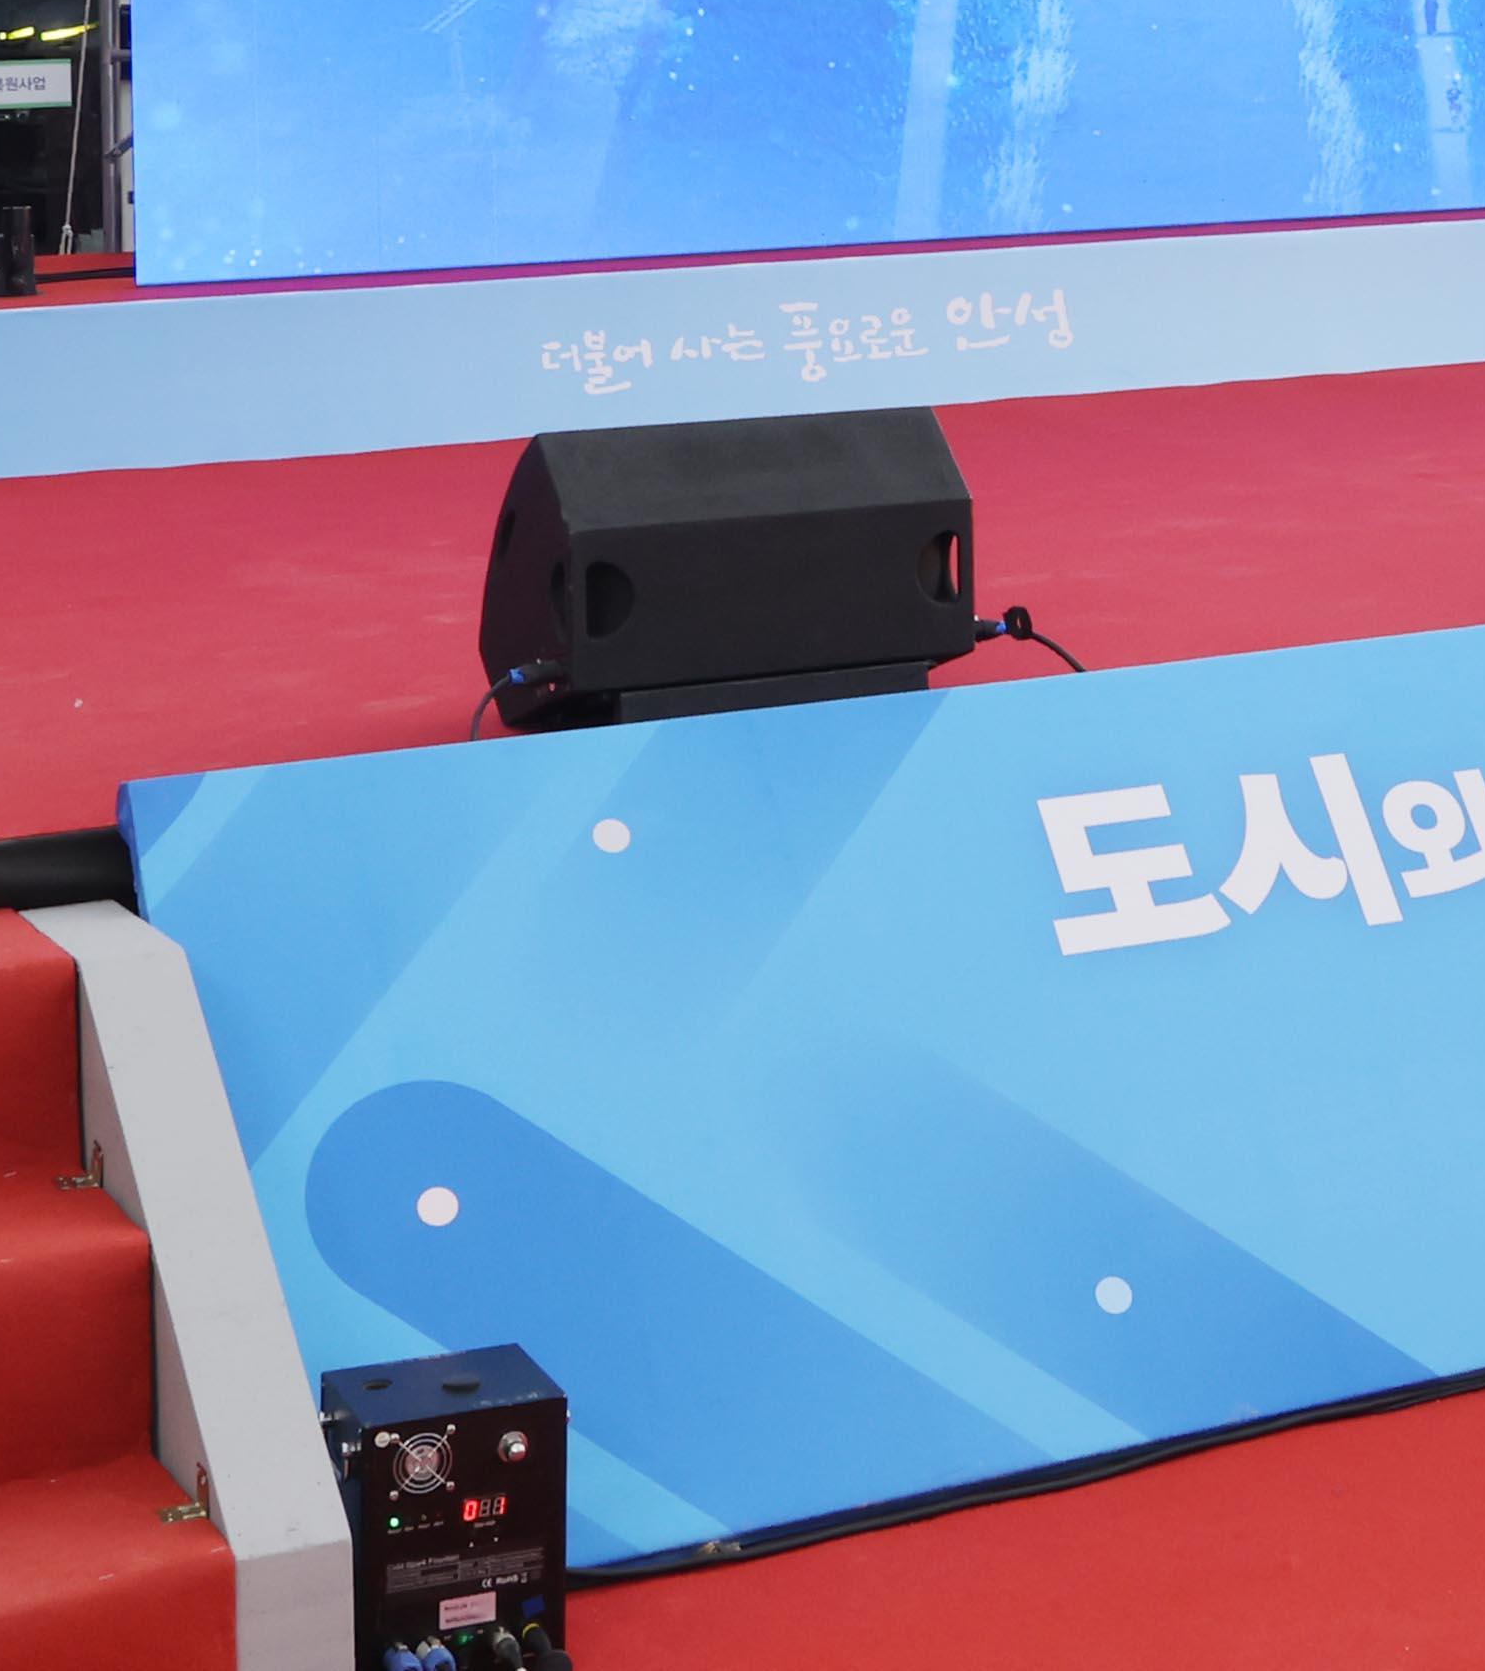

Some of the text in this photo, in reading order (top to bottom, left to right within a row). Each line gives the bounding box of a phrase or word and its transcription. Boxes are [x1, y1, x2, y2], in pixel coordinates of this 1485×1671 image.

[669, 324, 766, 362] 사는
[778, 301, 930, 383] 풍요로운
[945, 288, 1075, 350] 안성
